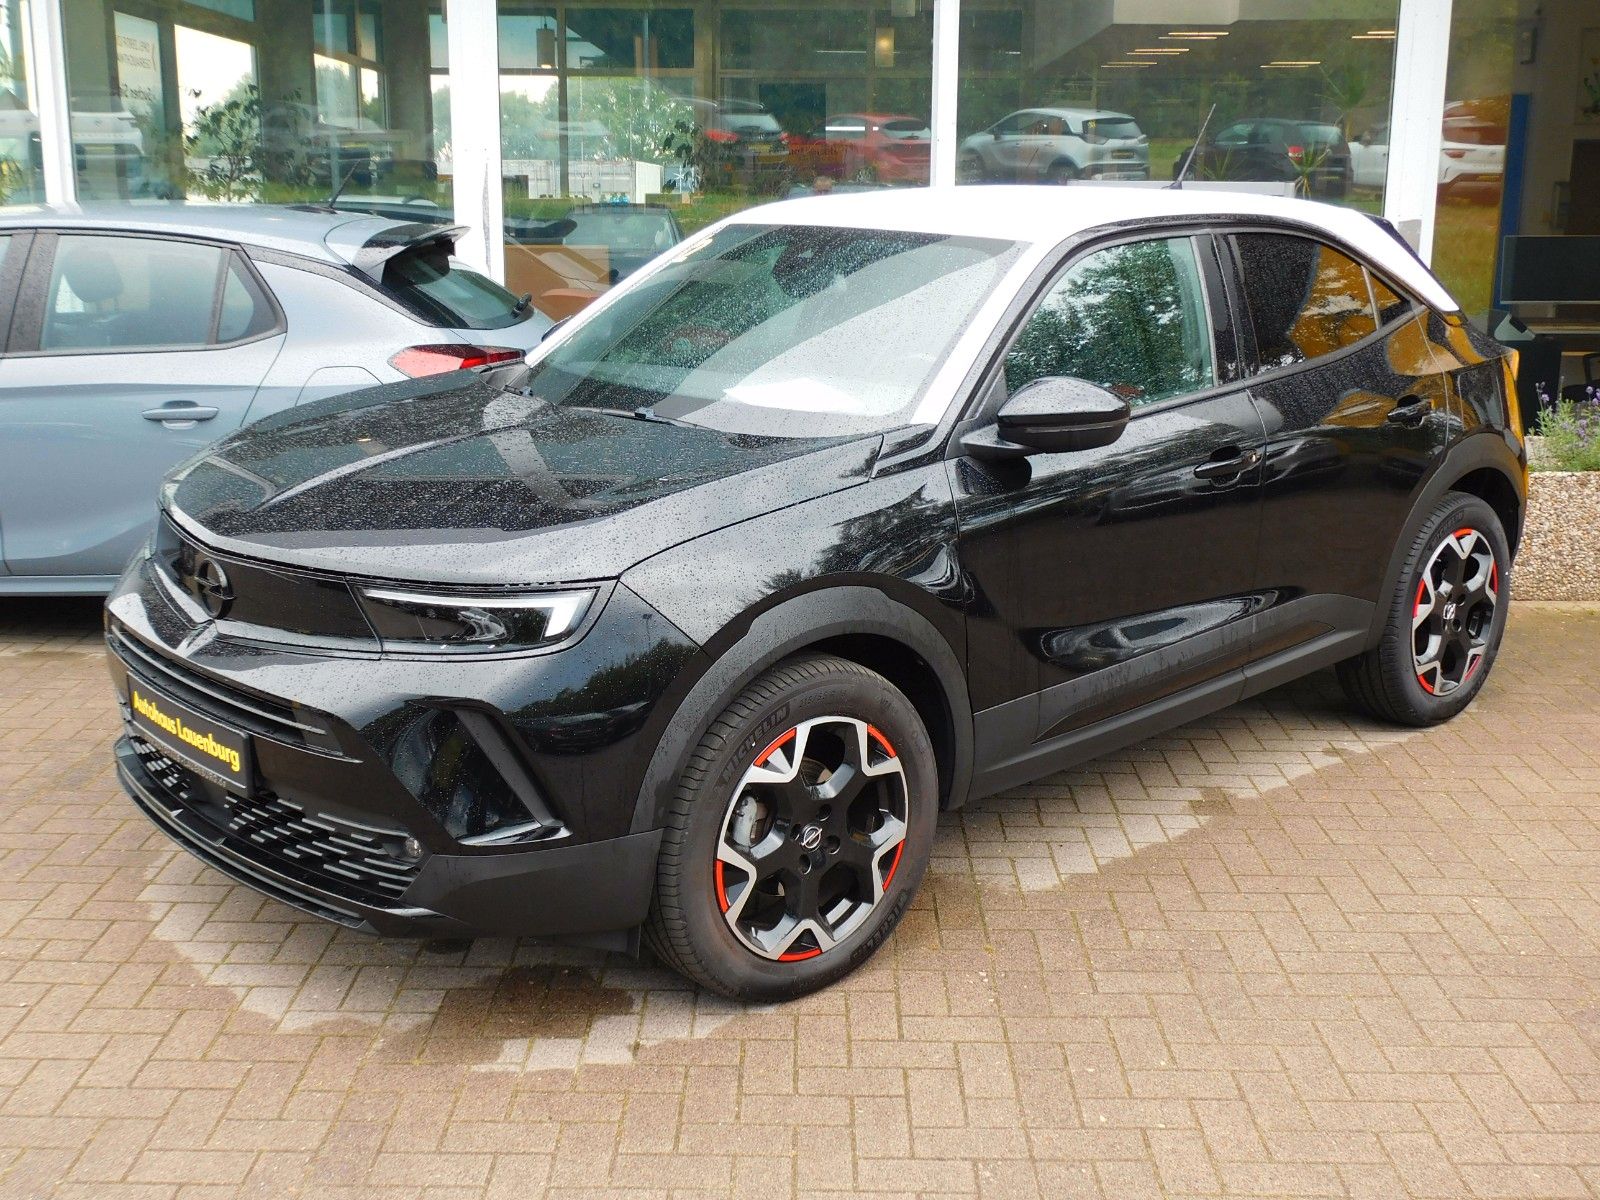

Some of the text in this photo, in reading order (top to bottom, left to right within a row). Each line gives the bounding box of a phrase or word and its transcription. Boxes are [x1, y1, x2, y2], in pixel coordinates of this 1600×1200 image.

[133, 690, 176, 734] Autohaus
[176, 718, 240, 772] Lauenburg
[722, 705, 787, 783] MICHELIN
